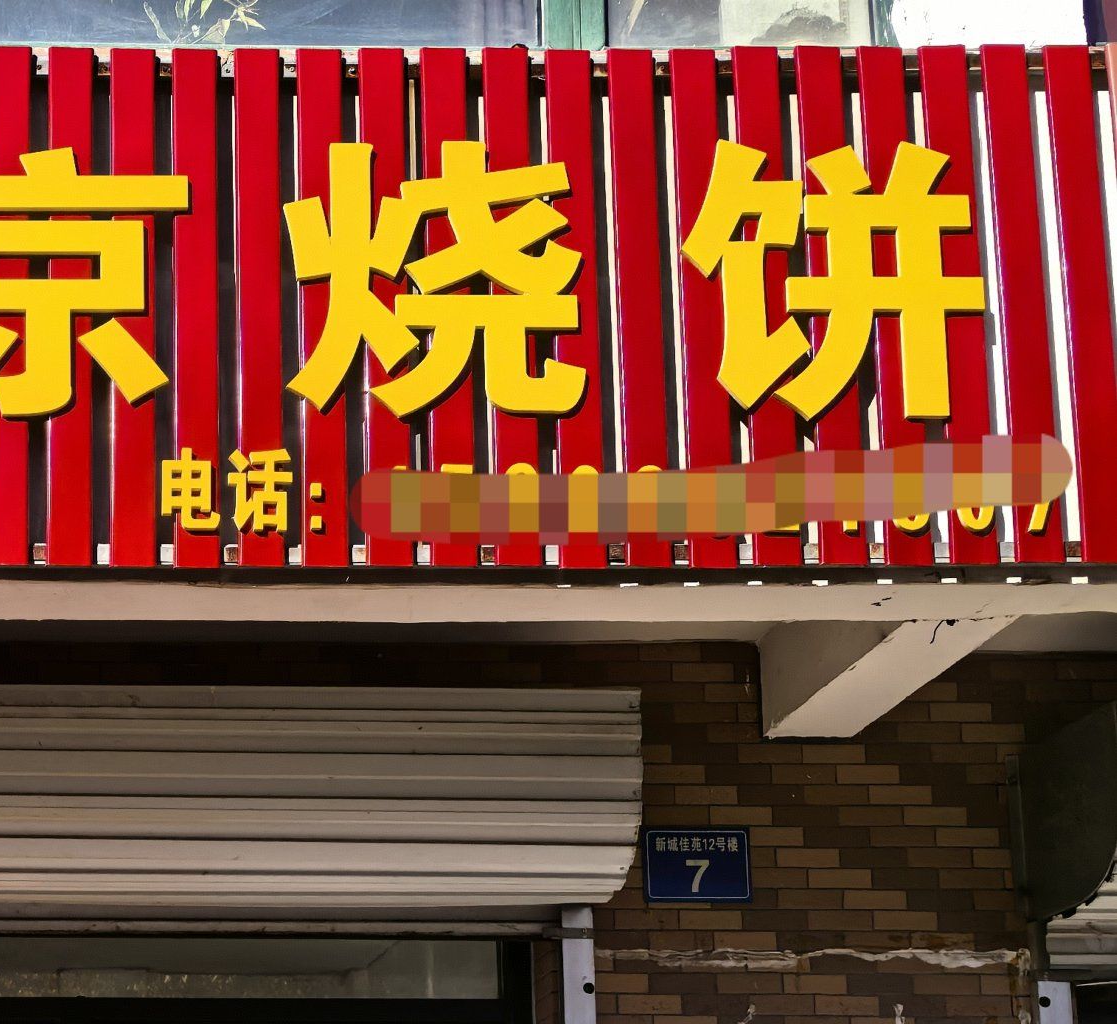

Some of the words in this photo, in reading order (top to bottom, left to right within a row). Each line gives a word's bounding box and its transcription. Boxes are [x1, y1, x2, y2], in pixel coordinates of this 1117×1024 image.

[655, 836, 739, 852] 新城佳苑12号楼
[685, 859, 710, 893] 7
